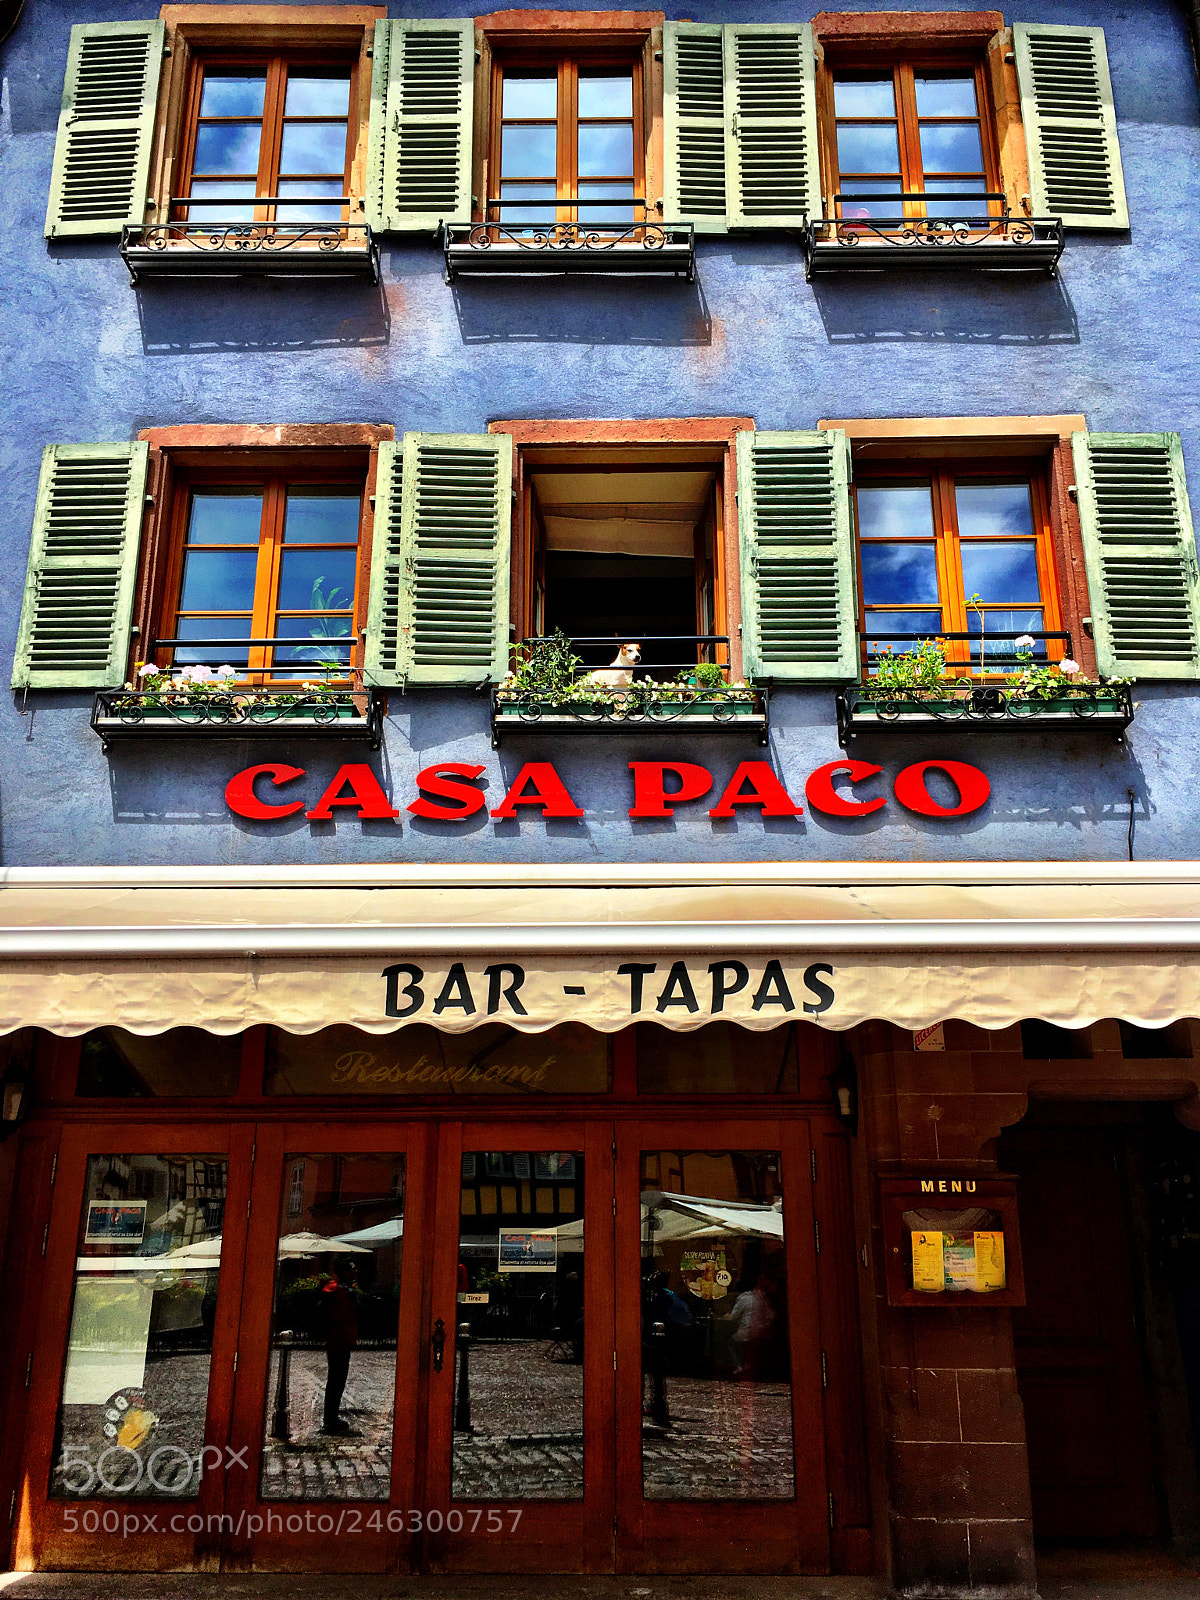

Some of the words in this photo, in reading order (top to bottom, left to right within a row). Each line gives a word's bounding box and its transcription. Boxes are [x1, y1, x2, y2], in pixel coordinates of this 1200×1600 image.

[225, 762, 584, 821] CASA
[628, 760, 991, 818] PACO
[382, 963, 528, 1018] BAR
[564, 985, 586, 995] -
[617, 960, 834, 1020] TAPAS
[331, 1051, 557, 1083] Restaurant
[921, 1180, 977, 1193] MENU
